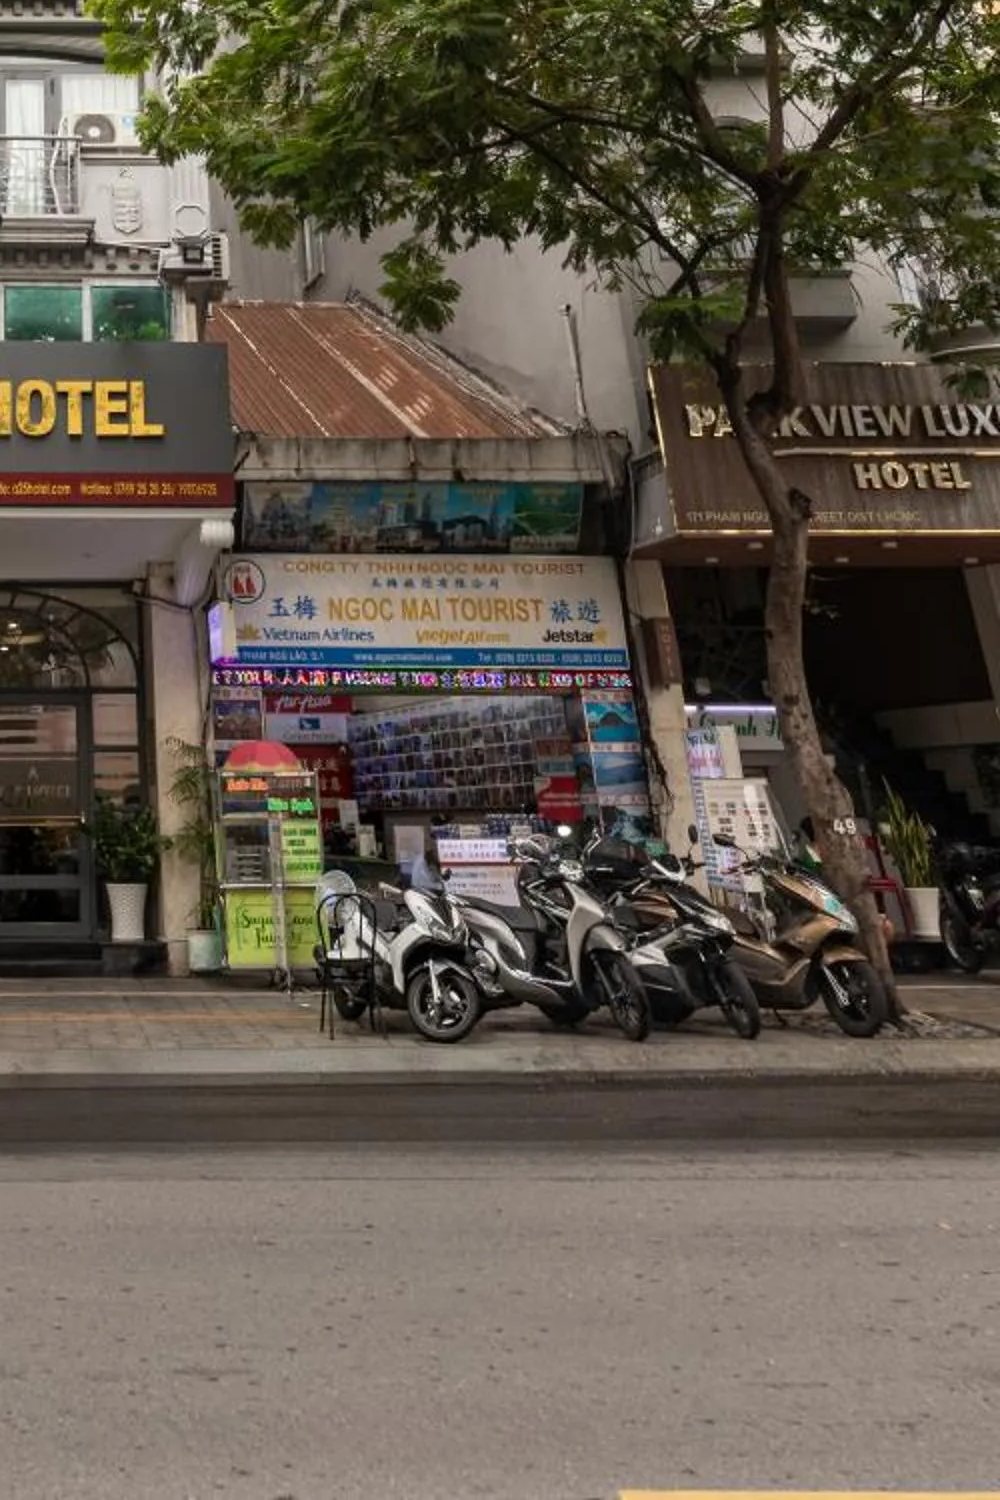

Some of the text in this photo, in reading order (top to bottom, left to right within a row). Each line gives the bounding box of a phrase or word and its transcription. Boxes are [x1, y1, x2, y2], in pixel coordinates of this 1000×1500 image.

[685, 403, 1000, 438] PAK VIEW LUX
[853, 461, 972, 489] HOTEL
[472, 561, 505, 574] MAI
[512, 561, 585, 575] TOURIST
[267, 595, 318, 620] 玉梅
[401, 597, 441, 621] MAI
[444, 597, 544, 622] TOURIST
[262, 627, 375, 642] Vietnam Airlines
[543, 629, 595, 644] Jetstar
[833, 818, 857, 835] 49
